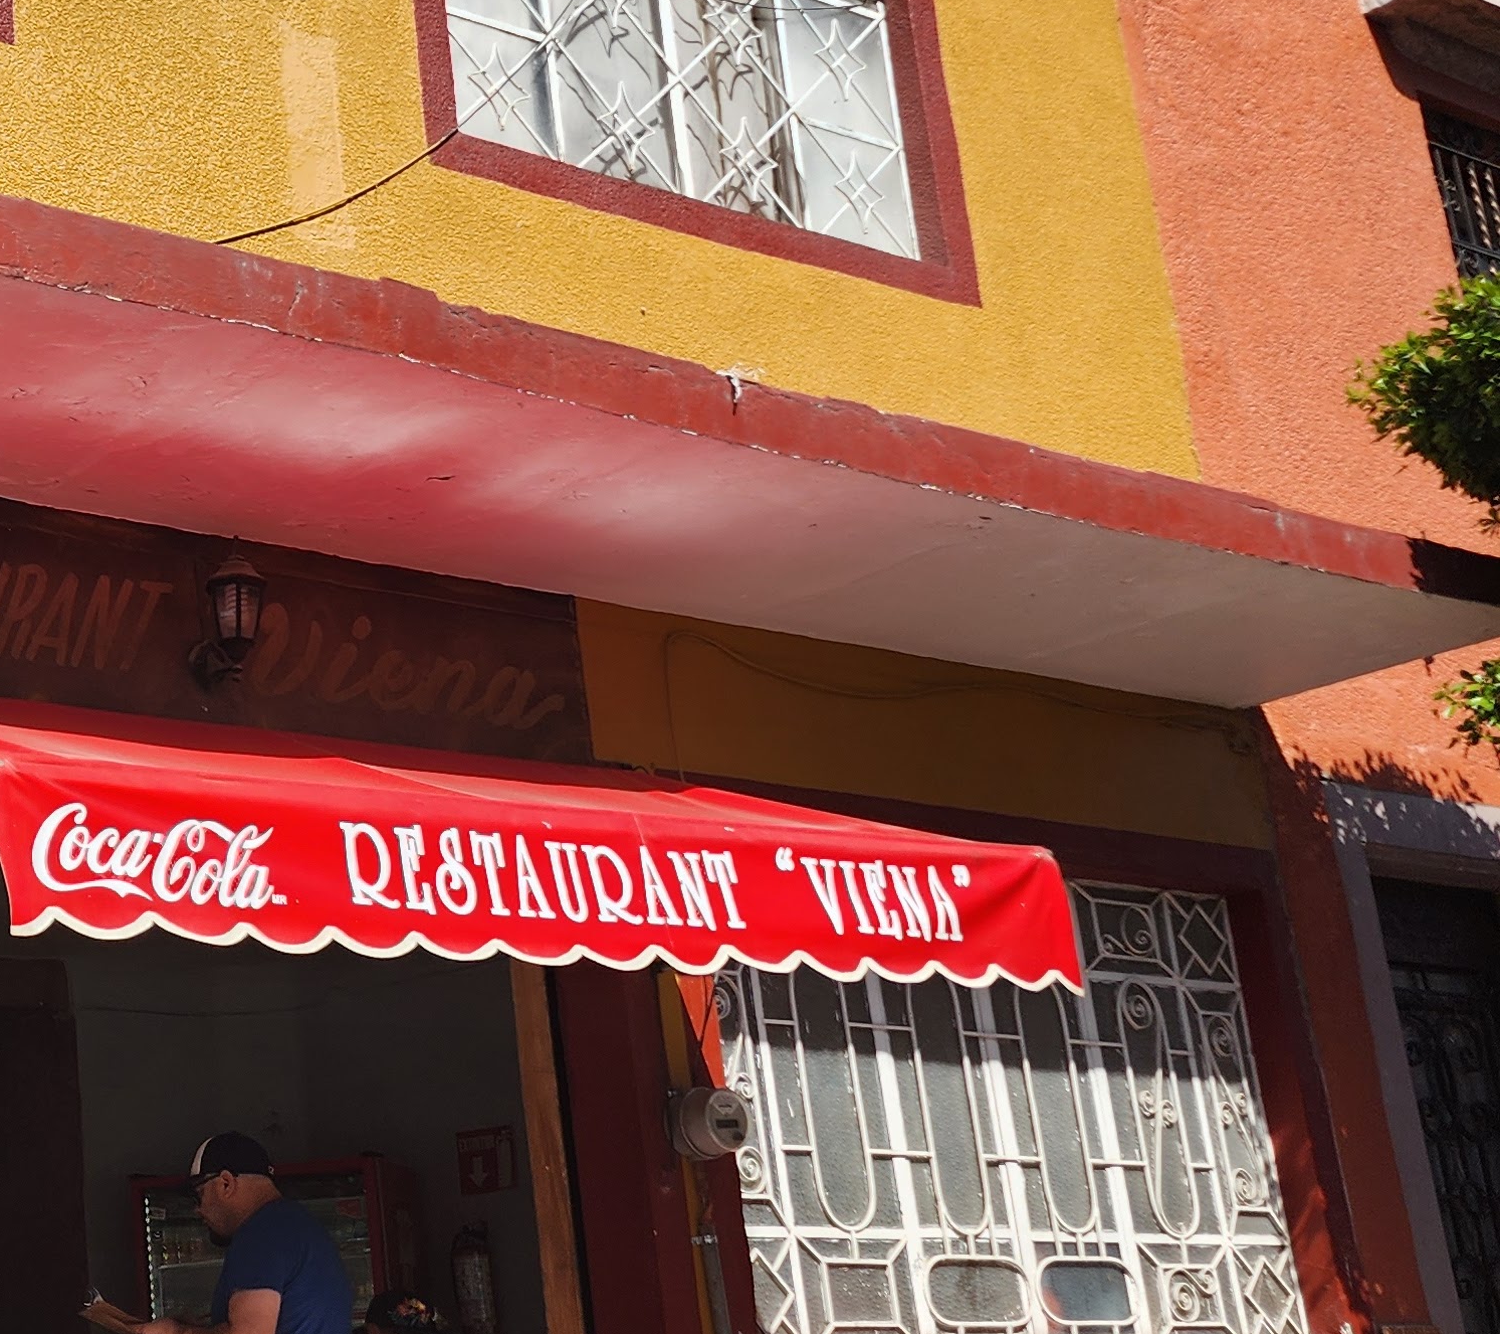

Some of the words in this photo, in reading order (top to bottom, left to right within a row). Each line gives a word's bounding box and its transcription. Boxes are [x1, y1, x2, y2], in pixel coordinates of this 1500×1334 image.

[32, 802, 274, 909] Coca-Cola
[339, 821, 747, 931] RESTAURANT
[775, 846, 971, 942] “VIENA”
